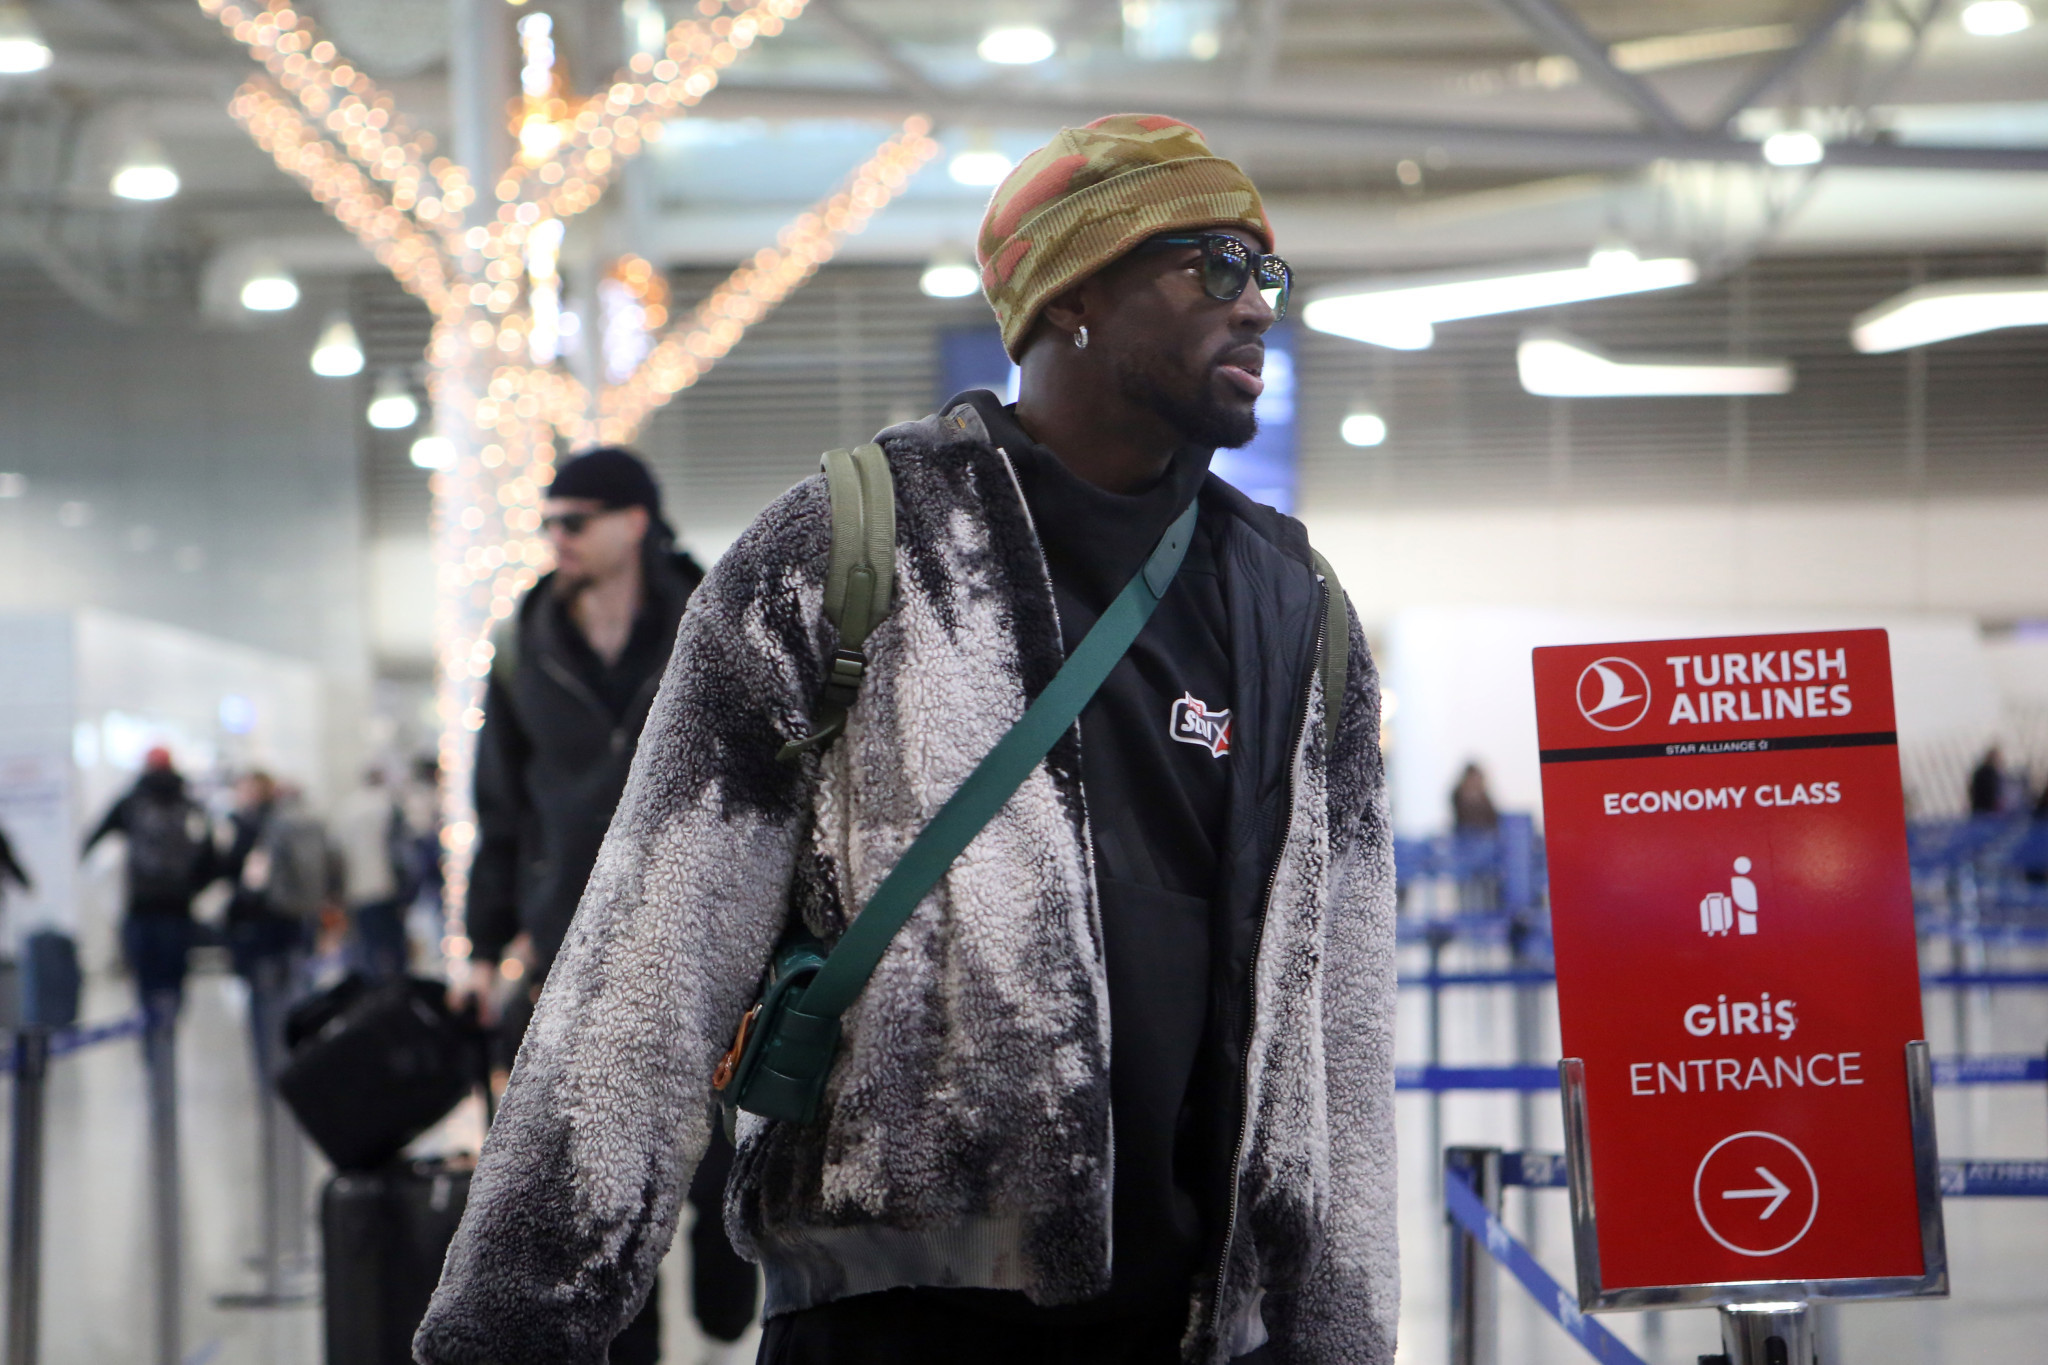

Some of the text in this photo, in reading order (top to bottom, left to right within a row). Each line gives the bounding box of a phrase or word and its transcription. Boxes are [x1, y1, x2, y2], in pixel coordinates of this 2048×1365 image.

[1666, 648, 1847, 688] TURKISH
[1668, 684, 1852, 725] AIRLINES
[1666, 740, 1756, 756] STAR ALLIANCE
[1603, 781, 1841, 815] ECONOMY CLASS
[1630, 1052, 1864, 1096] ENTRANCE
